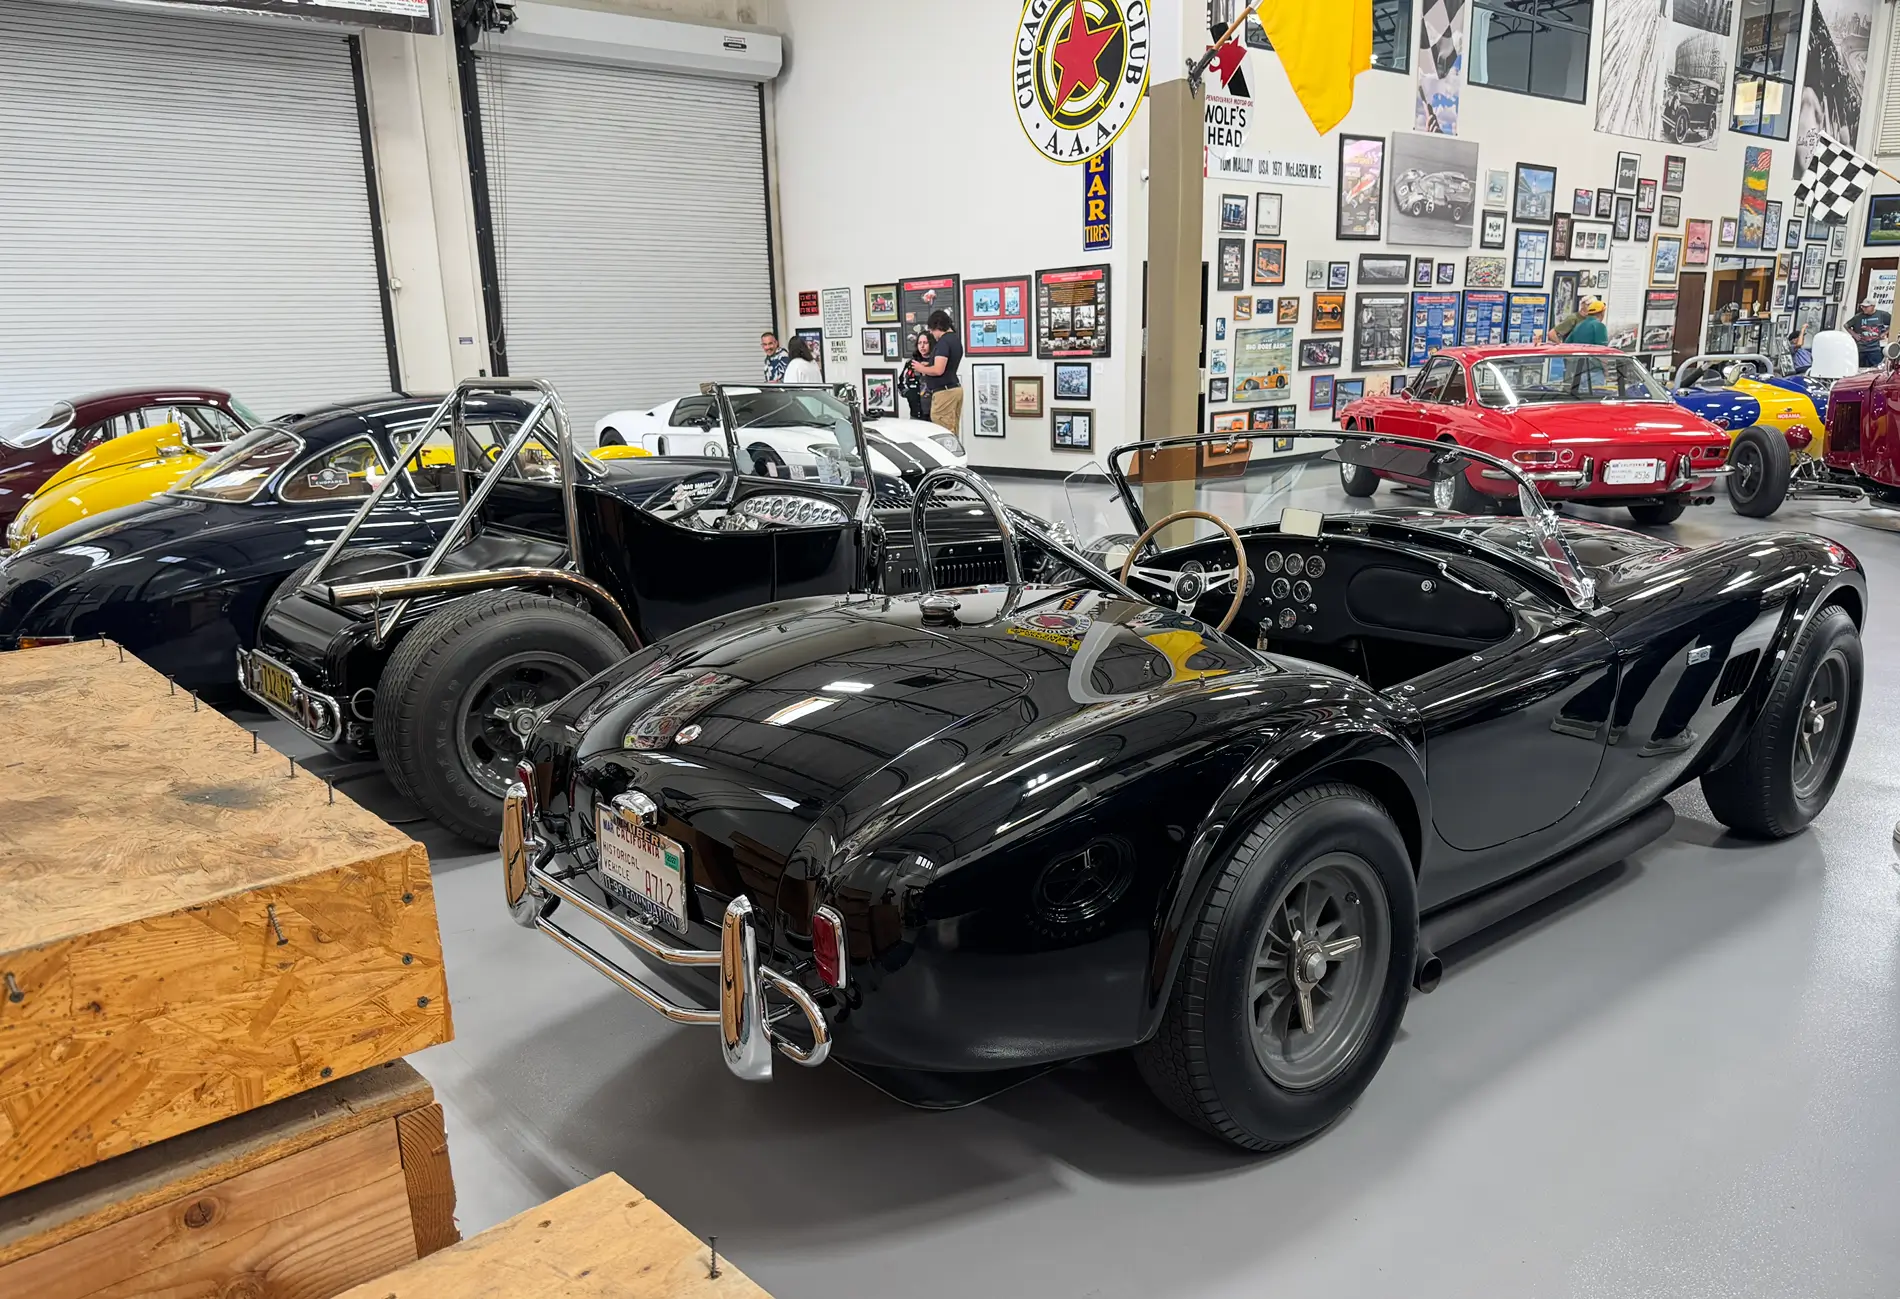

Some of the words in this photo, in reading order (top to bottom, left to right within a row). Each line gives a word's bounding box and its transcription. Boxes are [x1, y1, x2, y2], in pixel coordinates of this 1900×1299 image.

[1016, 0, 1052, 109] CHICAG
[1126, 0, 1147, 85] CLUB
[1207, 126, 1242, 148] HEAD
[1233, 157, 1253, 174] MALLOY
[1258, 159, 1269, 175] USA
[1272, 161, 1283, 176] 1971
[1285, 162, 1308, 179] McLAREN
[1318, 165, 1322, 180] E
[1085, 223, 1110, 243] TIRES
[436, 679, 493, 817] GOODYEAR
[602, 818, 614, 833] MAR
[602, 840, 640, 870] HISTORICAL
[616, 828, 660, 859] CALIFORNIA
[602, 856, 631, 881] VEHICLE
[603, 874, 623, 897] 11-99
[625, 887, 679, 931] FOUNDATION
[645, 870, 674, 912] A712
